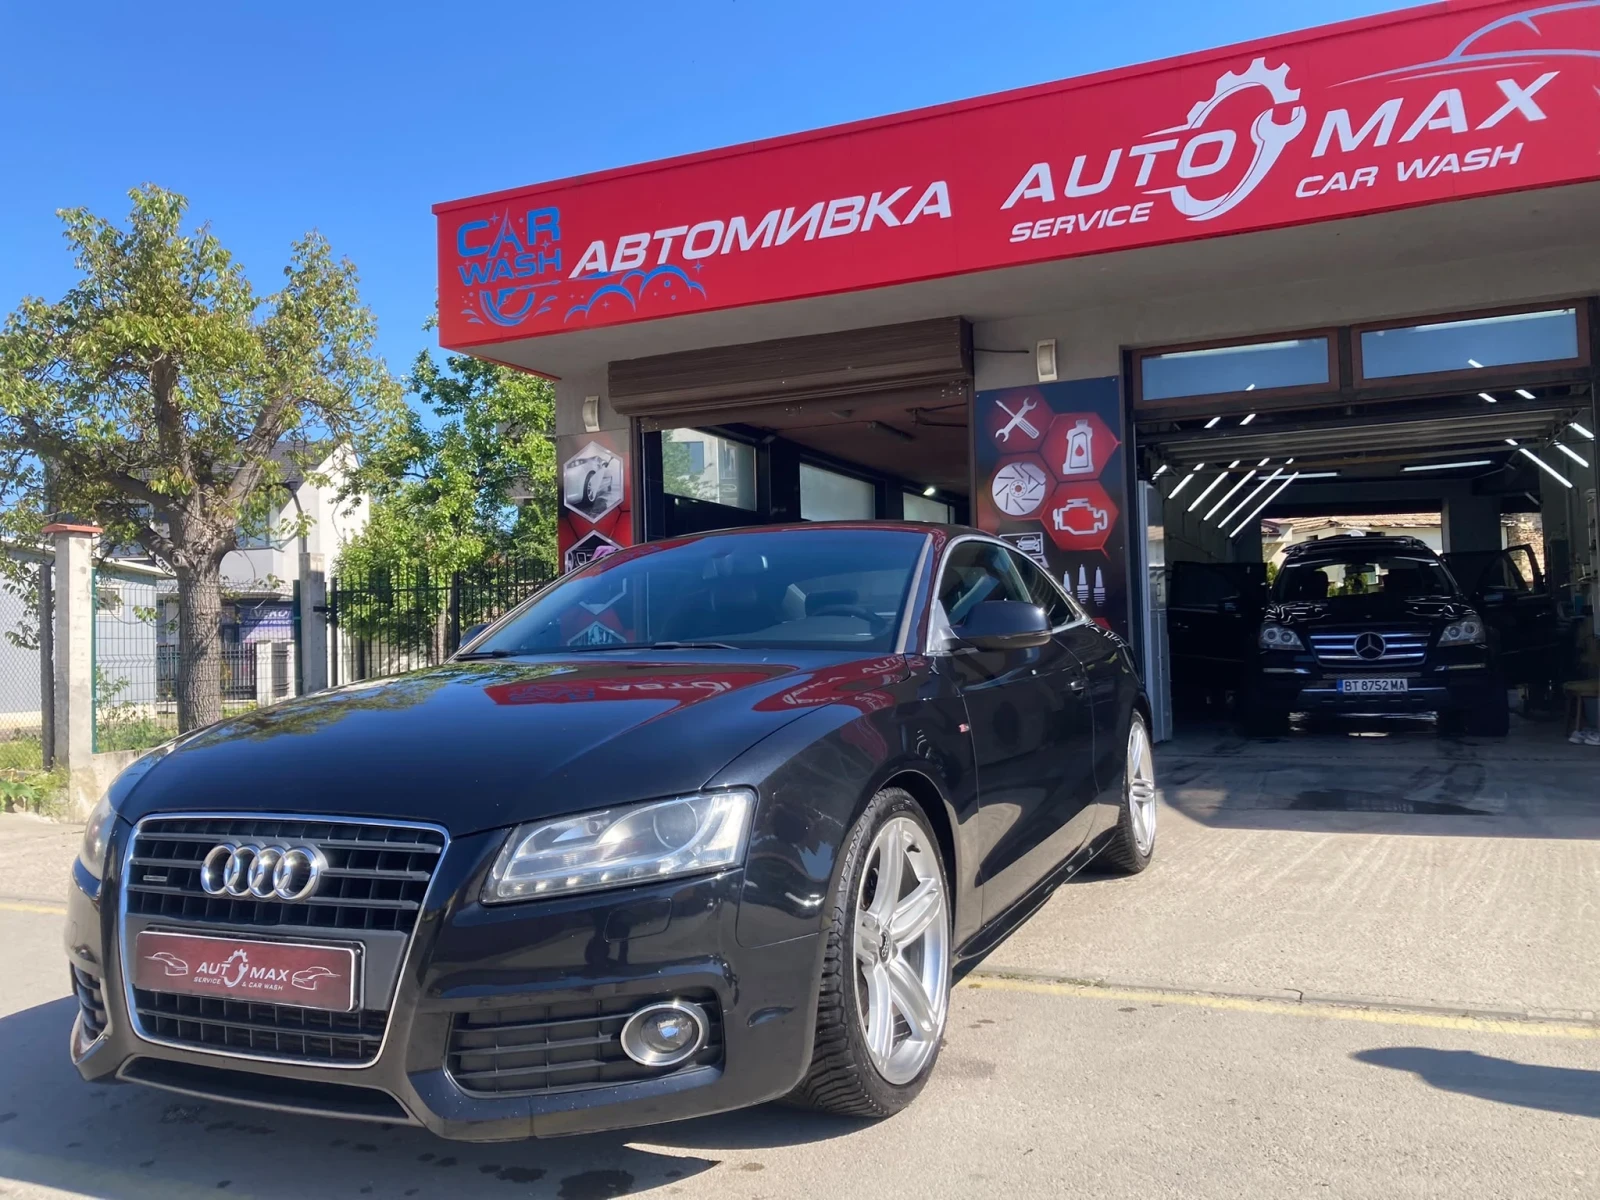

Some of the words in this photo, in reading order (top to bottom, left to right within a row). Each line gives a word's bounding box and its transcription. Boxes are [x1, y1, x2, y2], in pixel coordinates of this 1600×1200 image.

[1000, 129, 1237, 210] AUTO
[1311, 71, 1560, 158] MAX
[1009, 201, 1154, 243] SERVICE
[1295, 166, 1379, 198] CAR
[1397, 142, 1524, 182] WASH
[456, 206, 561, 259] CAR
[567, 181, 952, 279] АВТОМИВКА
[458, 248, 562, 286] WASH
[1344, 681, 1359, 691] BT
[1361, 680, 1389, 691] 8752
[1390, 680, 1405, 691] MA
[193, 976, 222, 985] SERVICE
[264, 983, 284, 991] WASH
[249, 966, 290, 982] MAX
